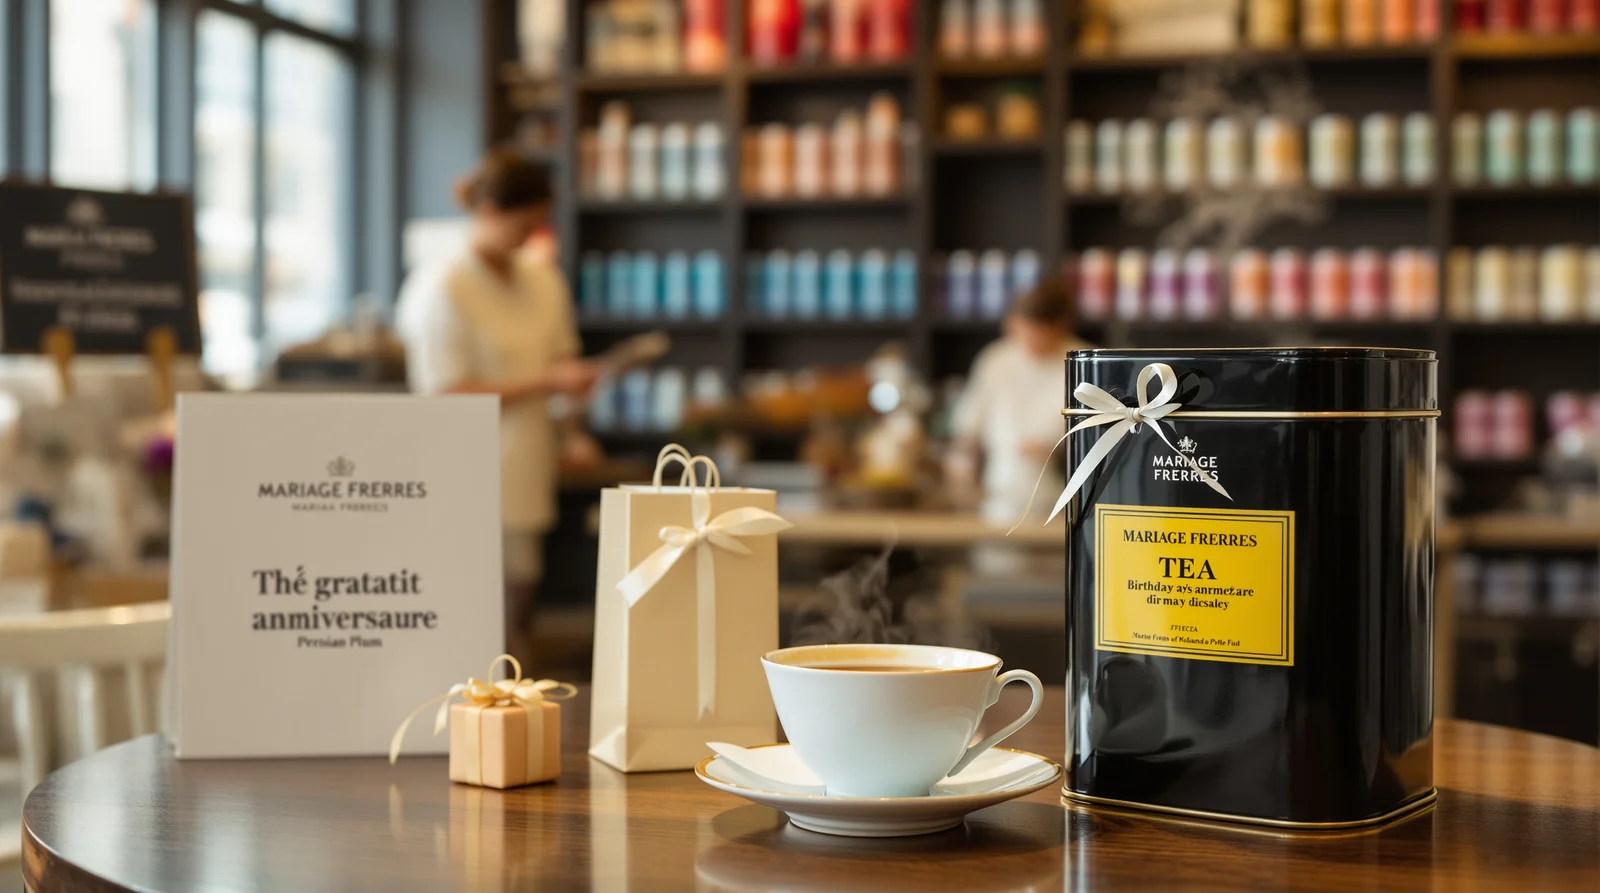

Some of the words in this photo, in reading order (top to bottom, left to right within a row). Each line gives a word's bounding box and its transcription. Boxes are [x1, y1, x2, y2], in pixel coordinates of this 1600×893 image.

[1153, 455, 1217, 468] MARIAGE
[258, 482, 342, 499] MARIAGE
[348, 481, 427, 499] FRERRES
[1123, 529, 1186, 544] MARIAGE
[1190, 532, 1257, 547] FRERRES
[1158, 557, 1217, 580] TEA
[253, 565, 307, 595] Thé
[315, 569, 421, 601] gratatit
[1127, 580, 1174, 594] Birthday
[253, 605, 438, 630] anmiversaure
